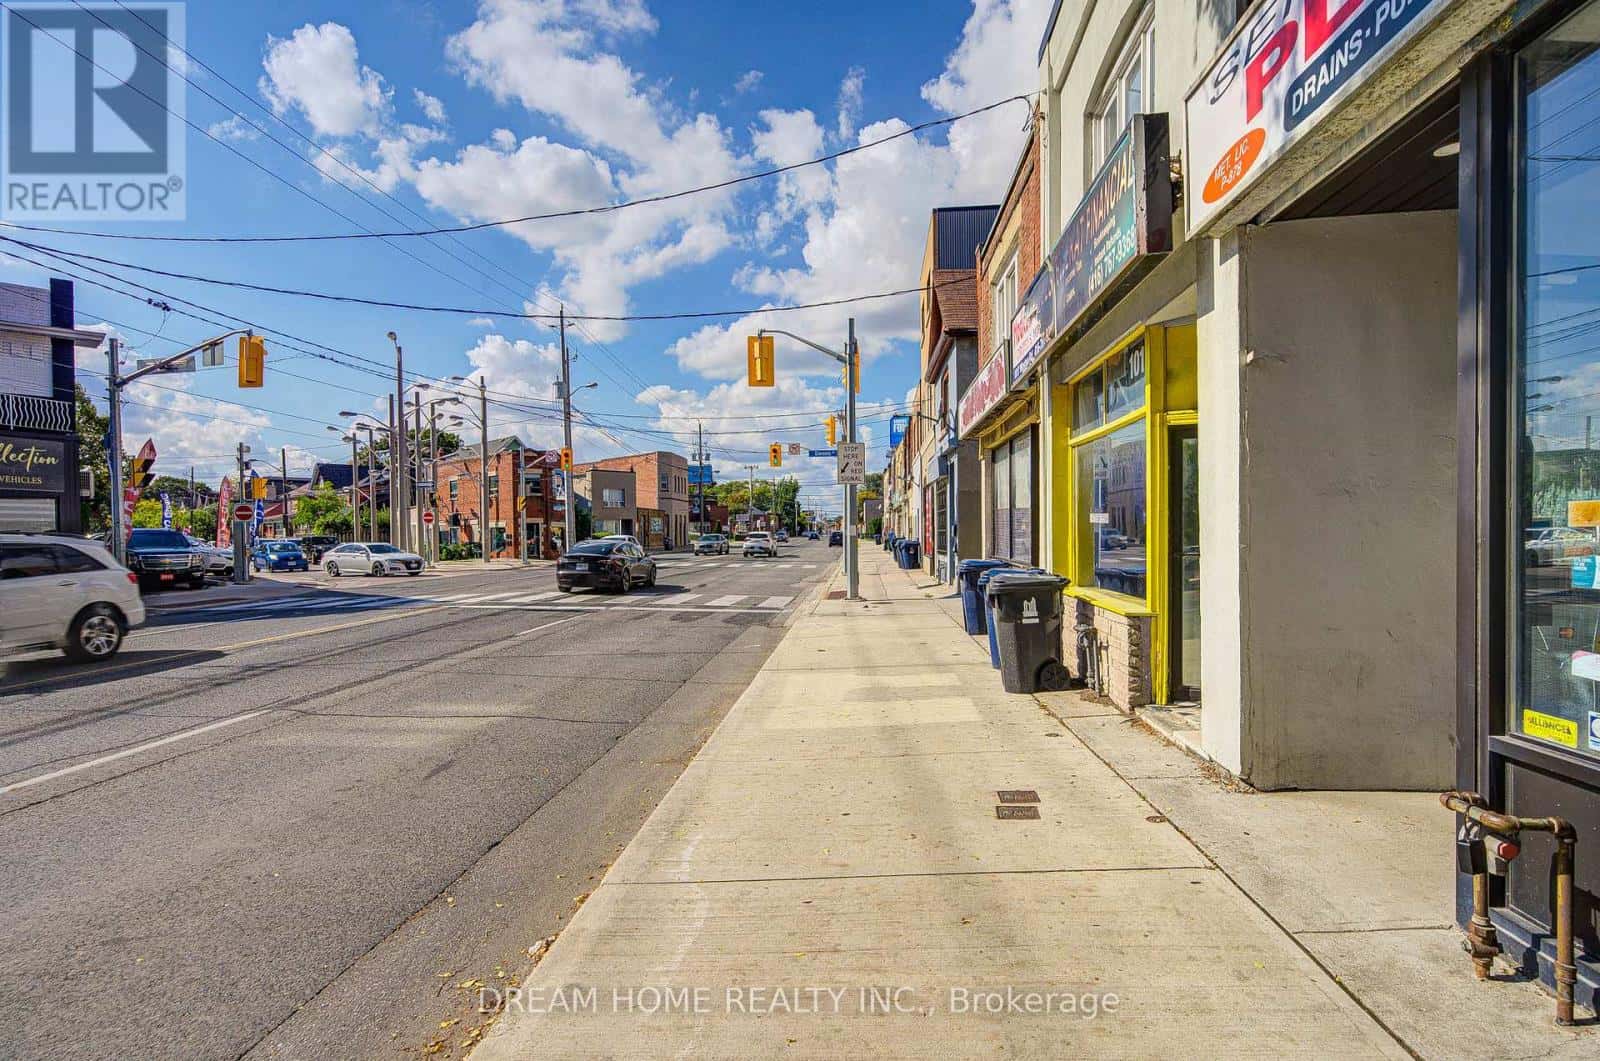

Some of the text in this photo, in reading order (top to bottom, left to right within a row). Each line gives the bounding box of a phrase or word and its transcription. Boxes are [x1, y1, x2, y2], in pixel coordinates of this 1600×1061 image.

[1291, 0, 1411, 116] DRAINS PU
[1129, 346, 1145, 379] 101
[0, 475, 42, 485] VEHICLES
